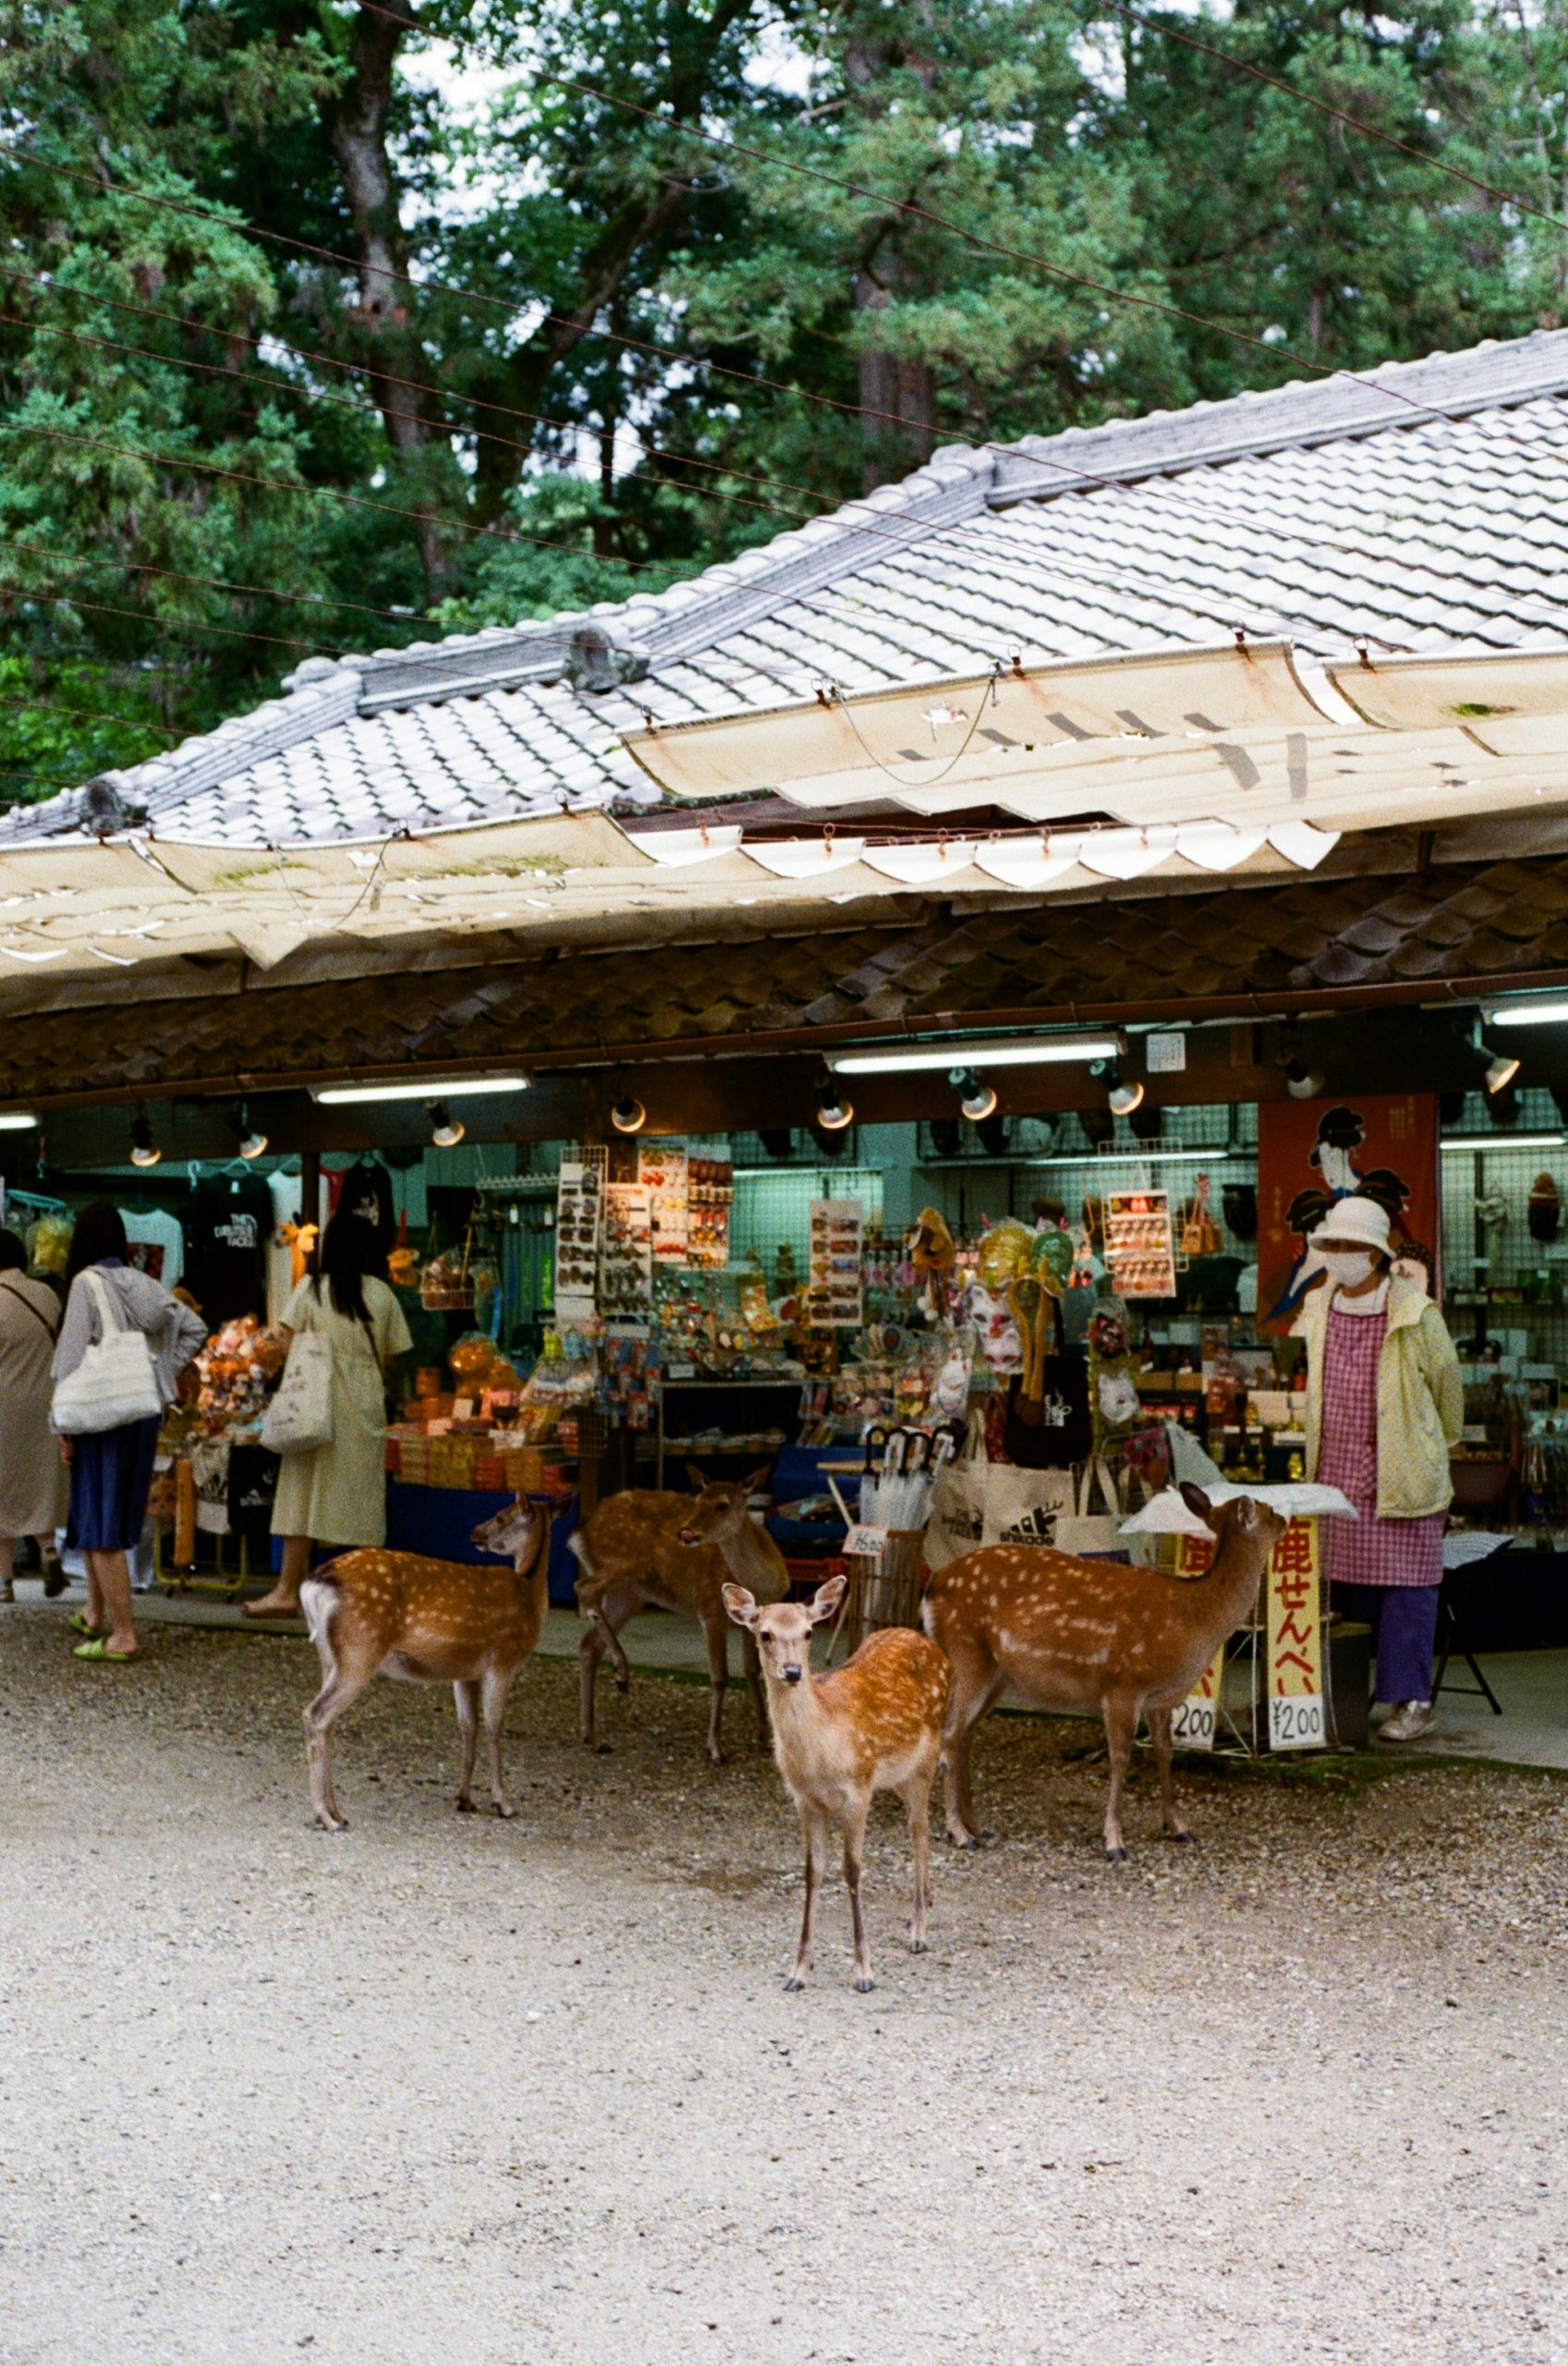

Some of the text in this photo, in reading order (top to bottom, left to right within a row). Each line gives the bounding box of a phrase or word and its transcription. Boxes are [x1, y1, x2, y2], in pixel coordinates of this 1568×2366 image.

[1000, 1531, 1054, 1546] shikade
[1271, 1516, 1314, 1696] 鹿せんべい
[1273, 1701, 1320, 1739] ¥200
